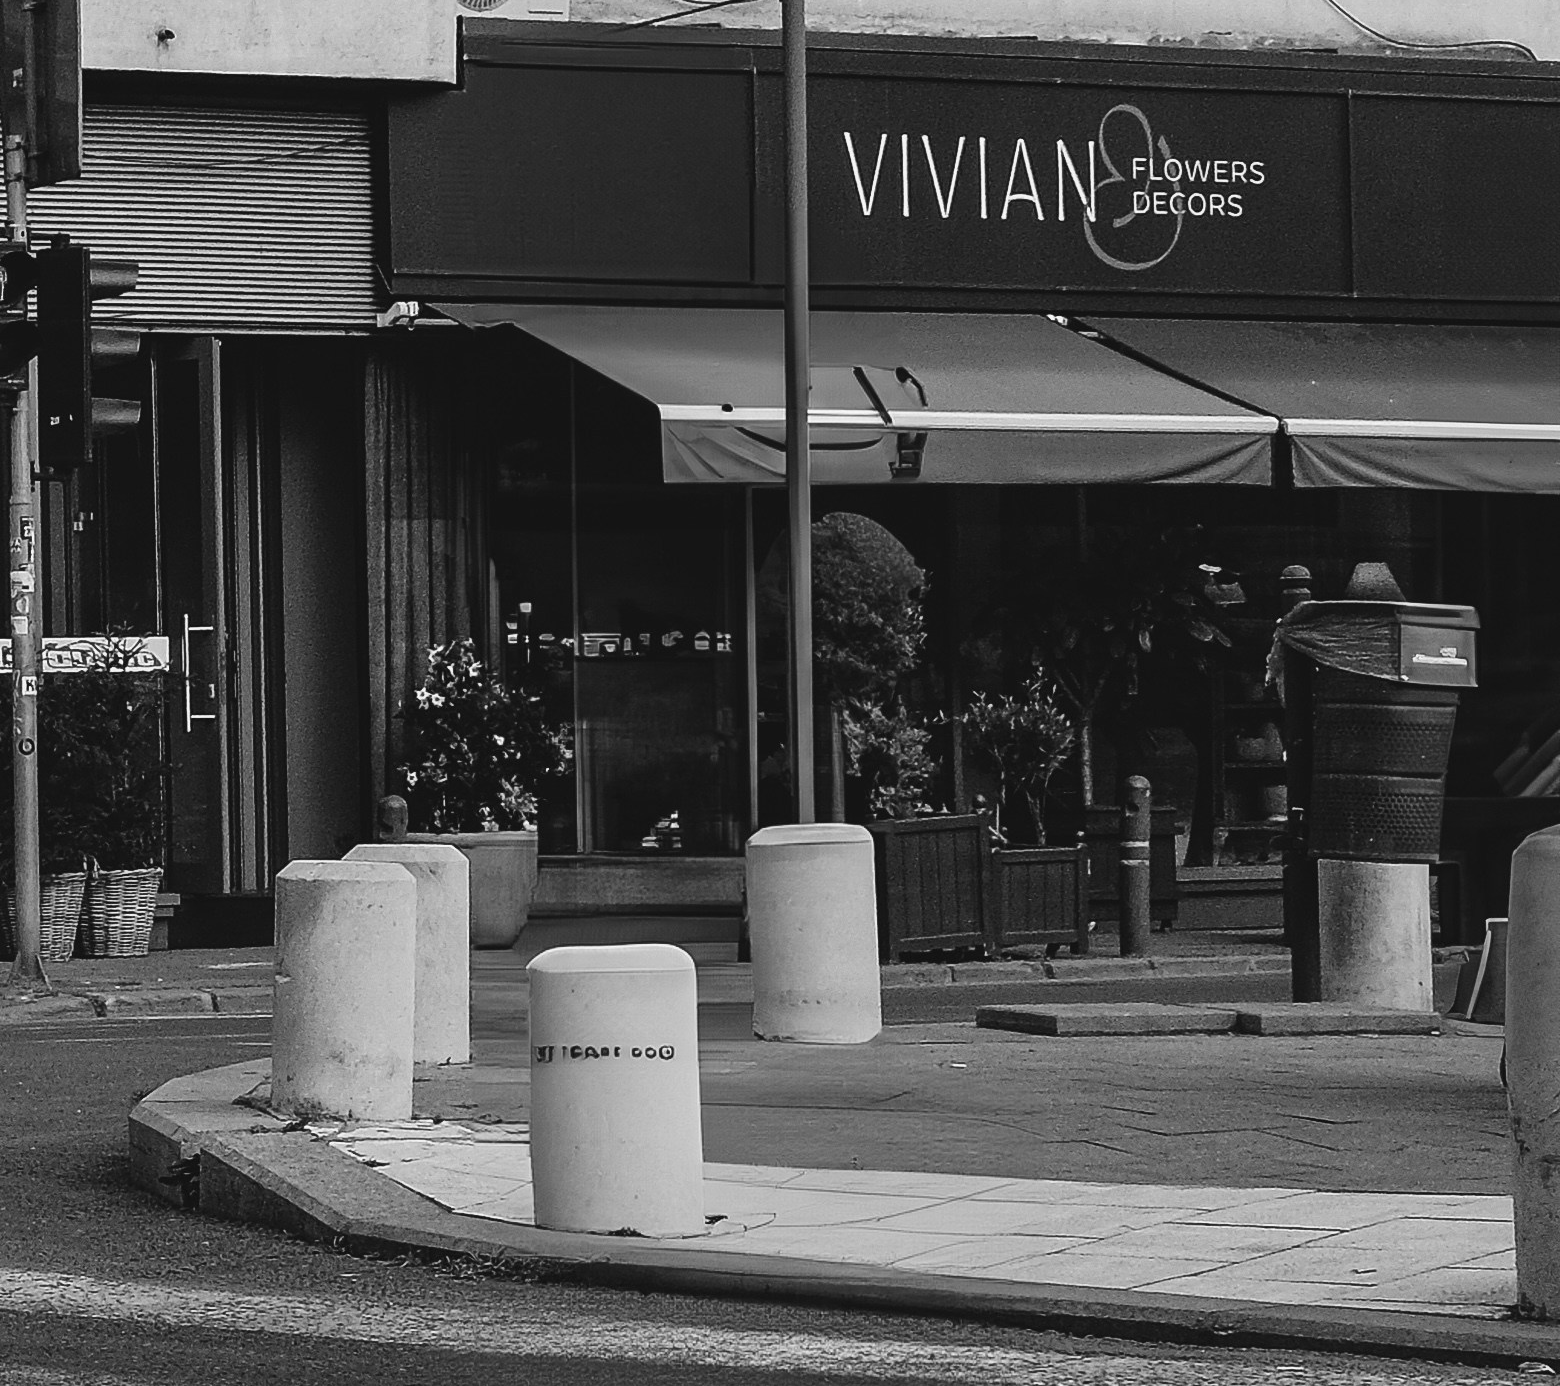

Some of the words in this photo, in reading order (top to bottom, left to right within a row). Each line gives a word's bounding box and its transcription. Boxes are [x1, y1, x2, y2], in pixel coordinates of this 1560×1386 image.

[844, 131, 1097, 223] VIVIAN
[1132, 158, 1266, 185] FLOWERS
[1132, 191, 1244, 217] DECORS
